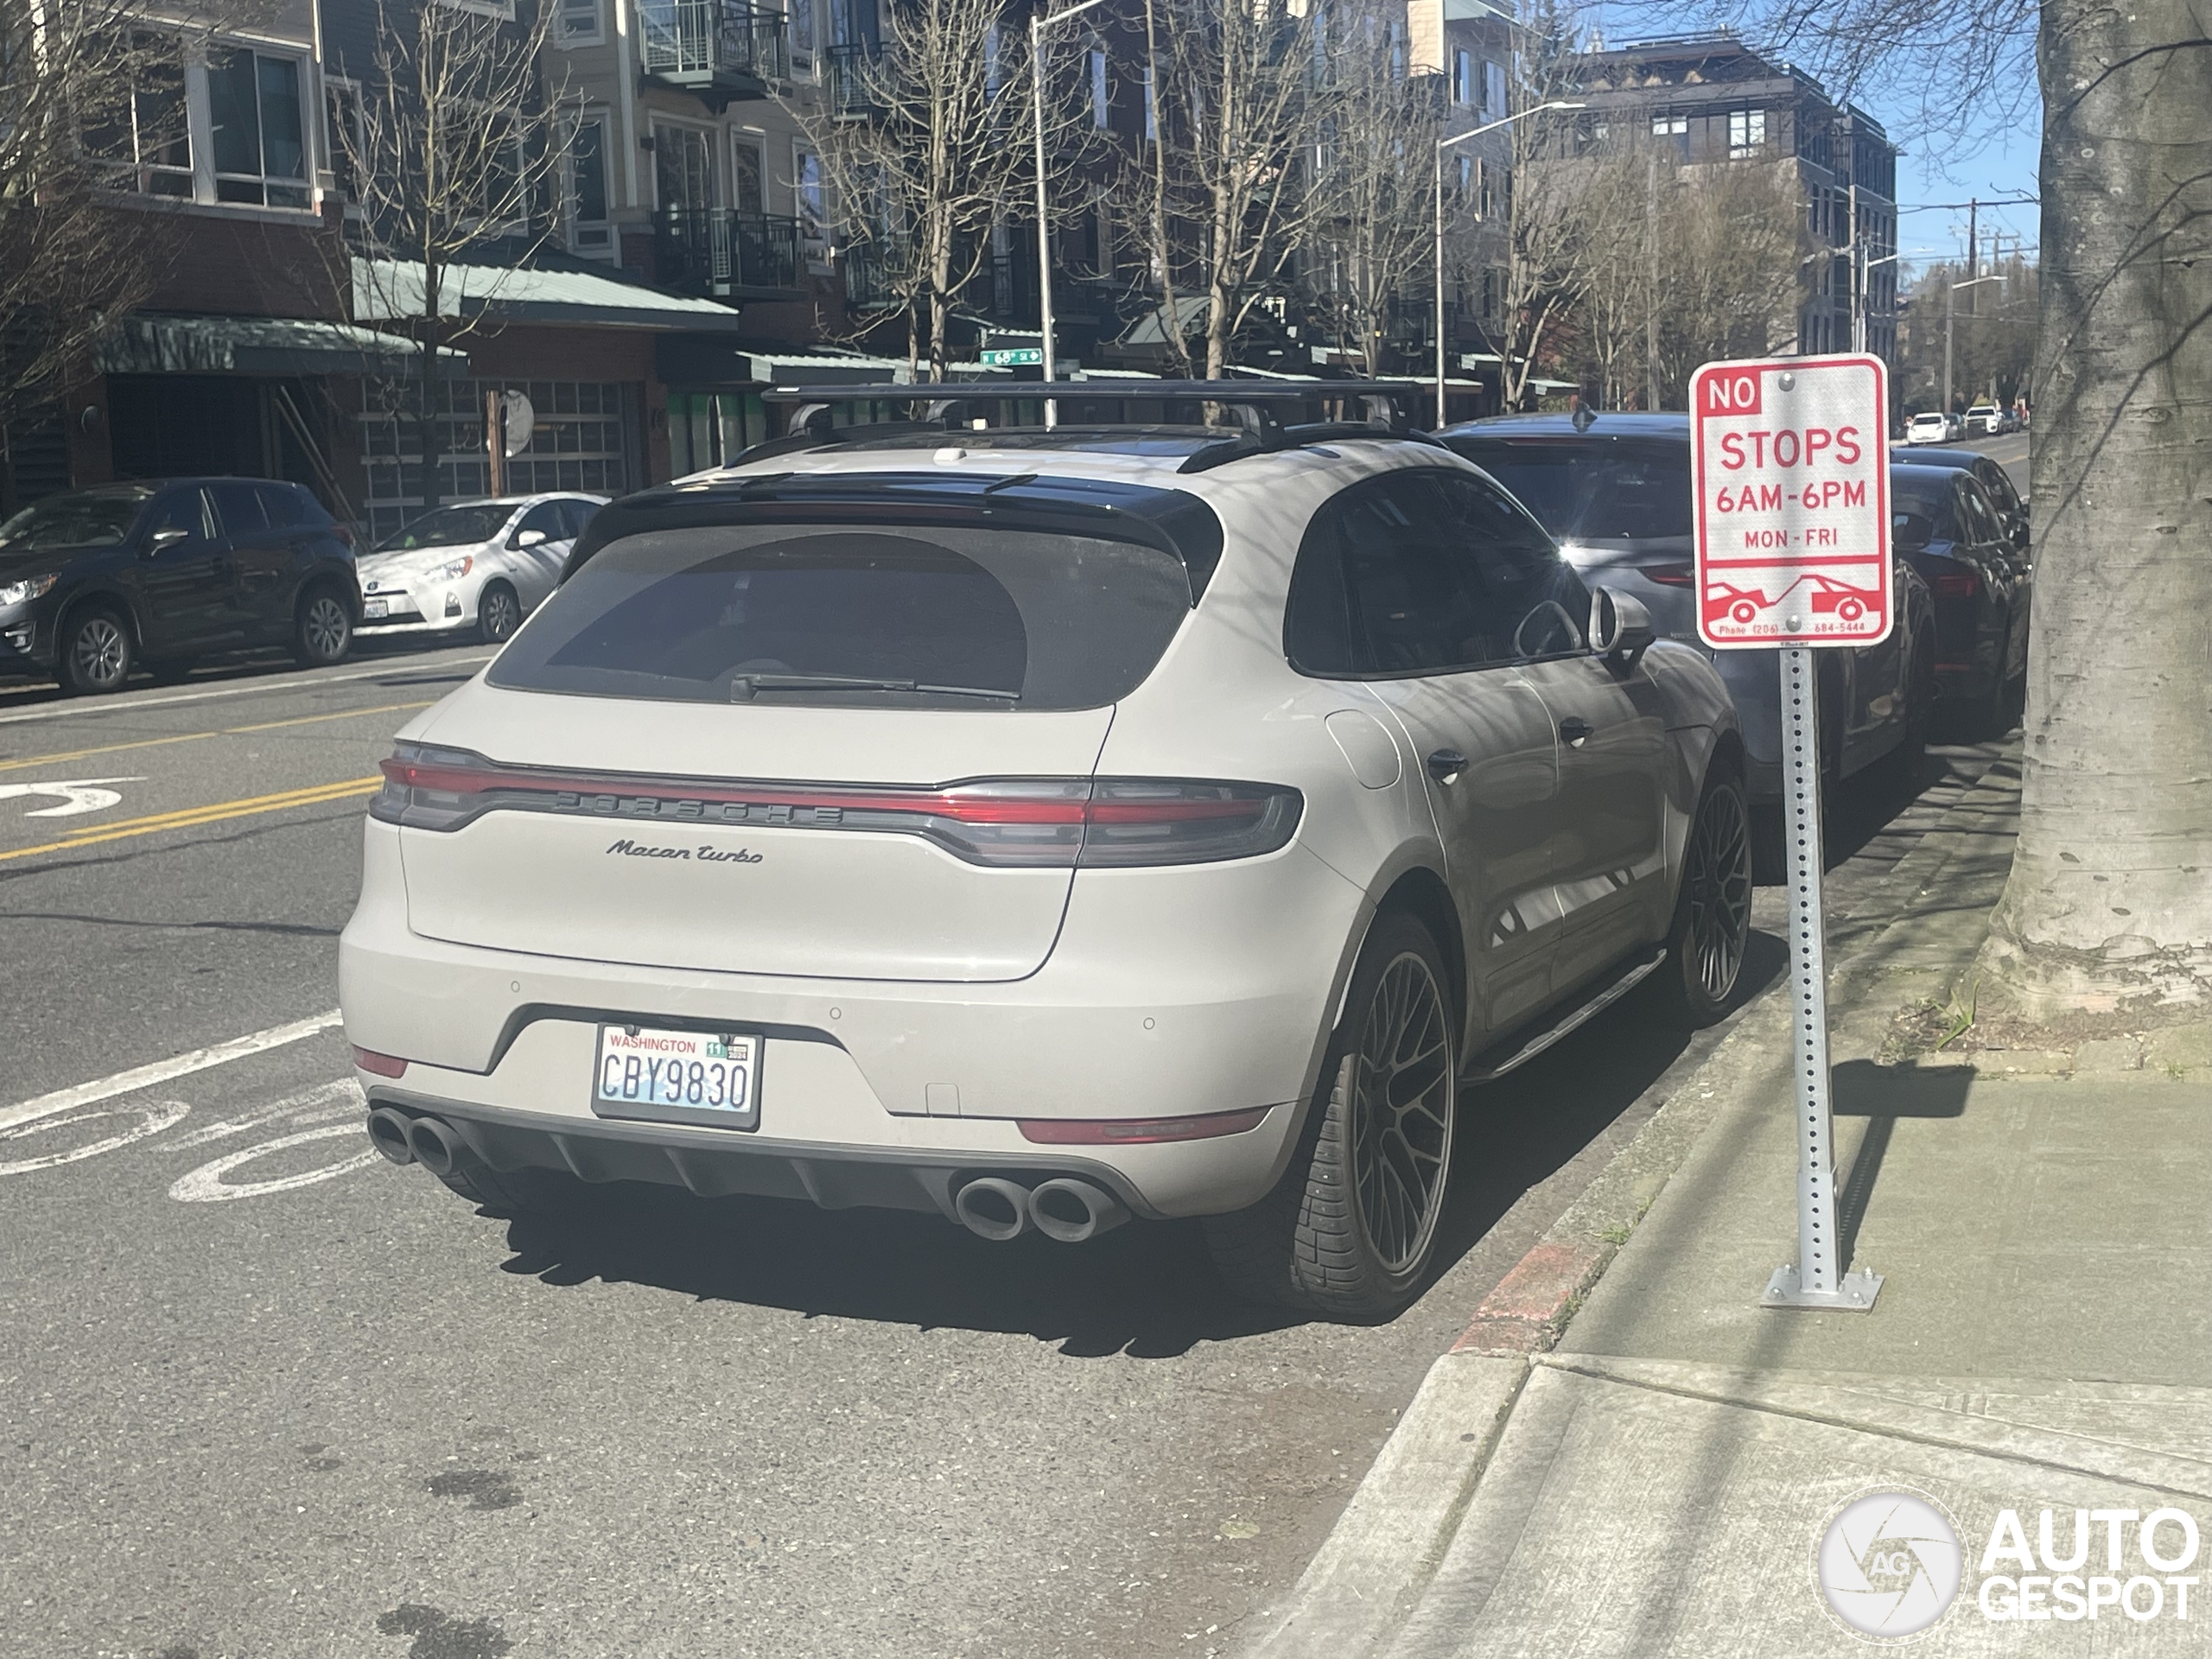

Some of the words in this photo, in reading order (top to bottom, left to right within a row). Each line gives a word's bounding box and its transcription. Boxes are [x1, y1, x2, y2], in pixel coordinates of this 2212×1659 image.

[1708, 377, 1756, 410] NO
[1721, 426, 1861, 470] STOPS
[1717, 480, 1866, 512] 6AM-6PM
[1719, 626, 1746, 635] Phone
[1753, 624, 1779, 634] (206)
[1815, 622, 1866, 632] 684-5444
[555, 791, 843, 825] PORSCHE
[606, 839, 691, 860] Macan
[610, 1034, 696, 1054] WASHINGTON
[708, 1042, 721, 1055] 11
[602, 1053, 747, 1109] CBY9830
